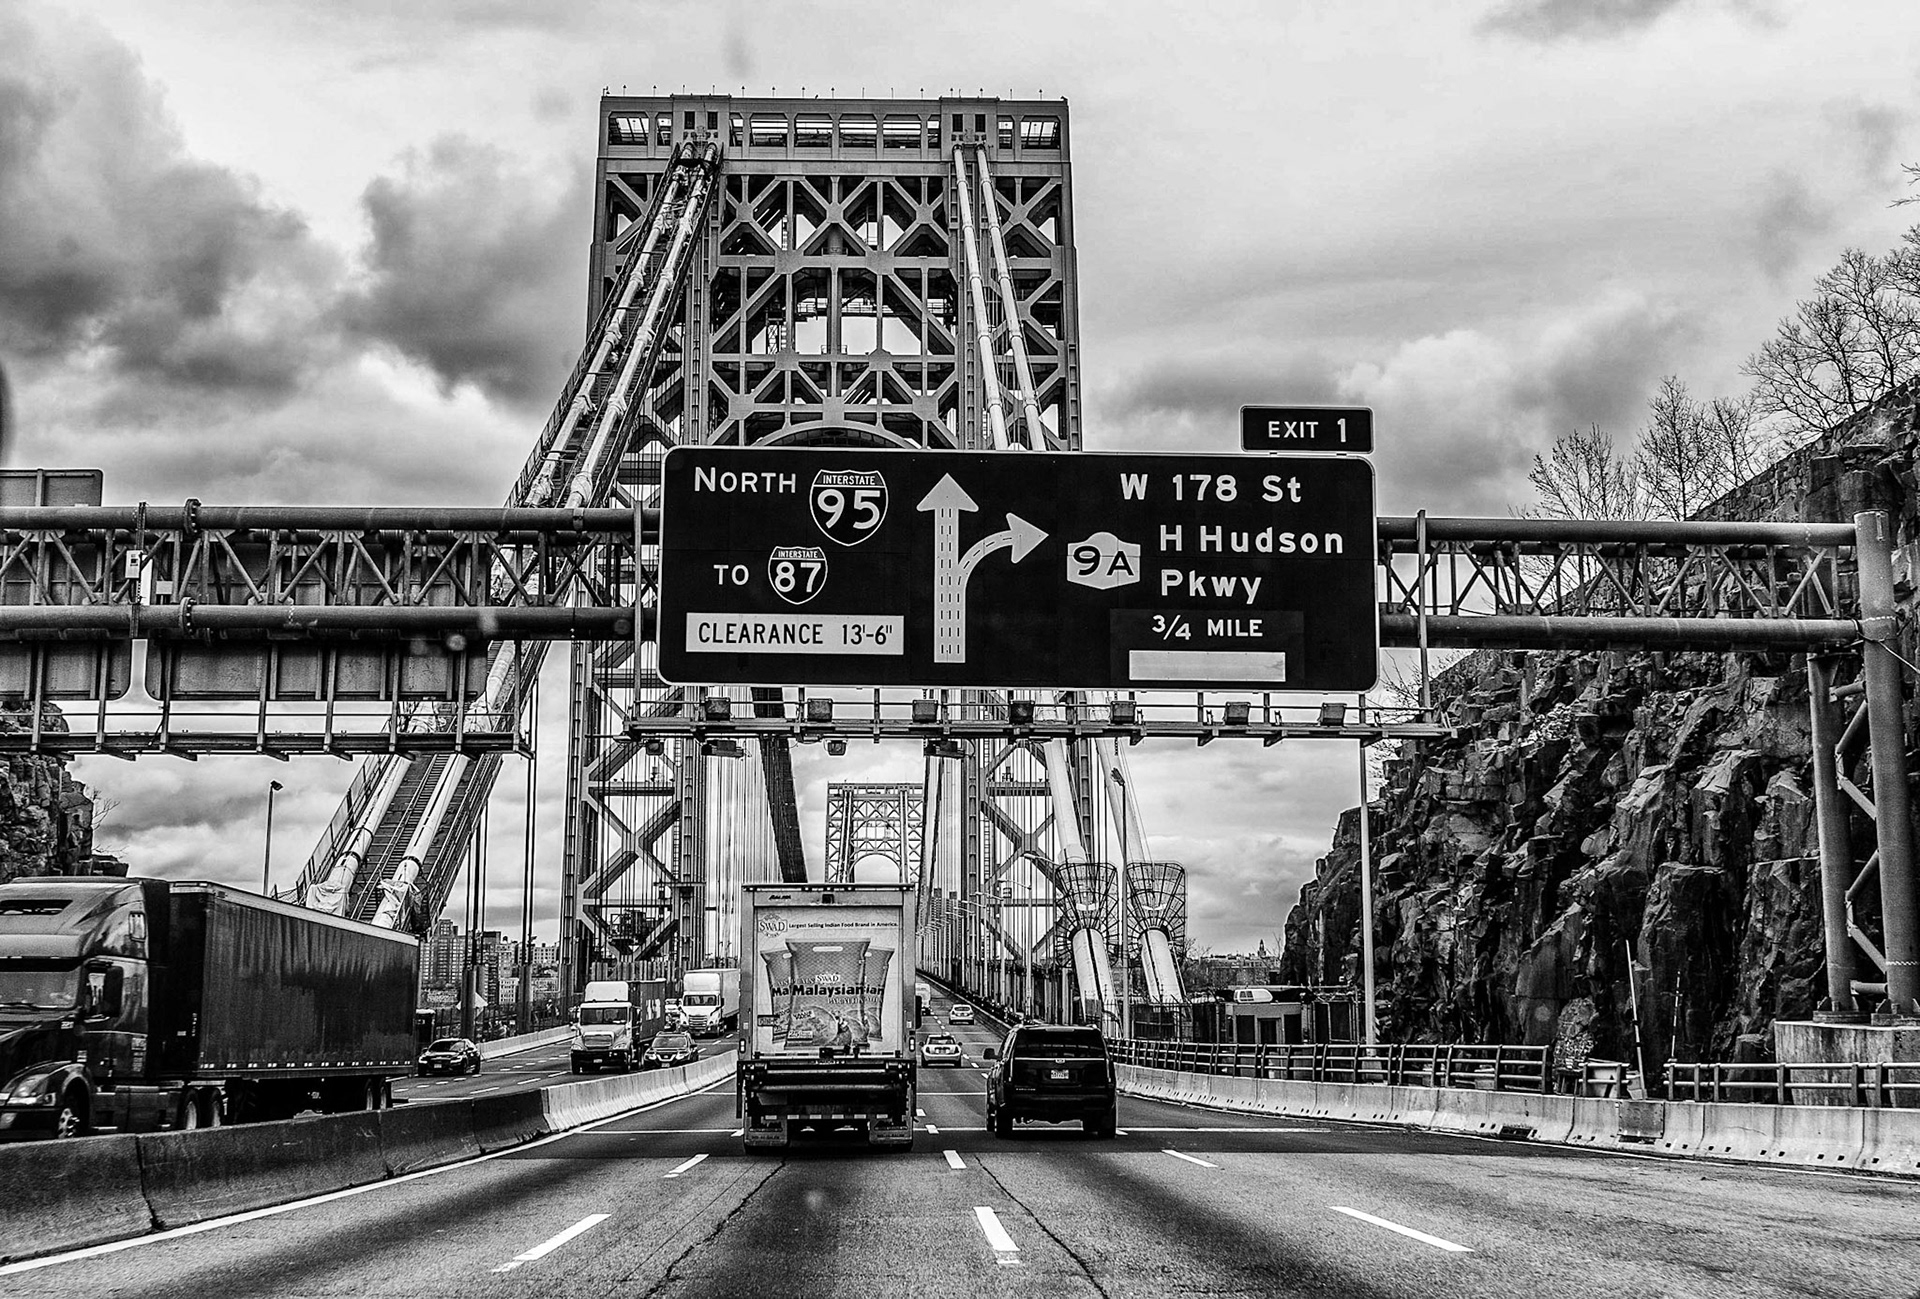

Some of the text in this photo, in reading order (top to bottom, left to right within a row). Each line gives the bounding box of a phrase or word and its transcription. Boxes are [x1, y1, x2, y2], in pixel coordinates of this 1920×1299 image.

[1268, 418, 1347, 443] EXIT 1
[694, 466, 796, 494] NORTH
[822, 474, 876, 486] INTERSTATE
[1120, 473, 1302, 503] W 178 St
[817, 488, 881, 530] 95
[1160, 524, 1344, 555] H Hudson
[778, 549, 819, 559] INTERSTATE
[1073, 545, 1135, 576] 9A
[713, 564, 749, 586] TO
[774, 561, 822, 593] 87
[1161, 569, 1262, 605] Pkwy
[698, 622, 824, 645] CLEARANCE
[1151, 614, 1263, 641] 3/4 MILE
[759, 920, 786, 932] SWAD
[792, 983, 864, 998] Malaysian
